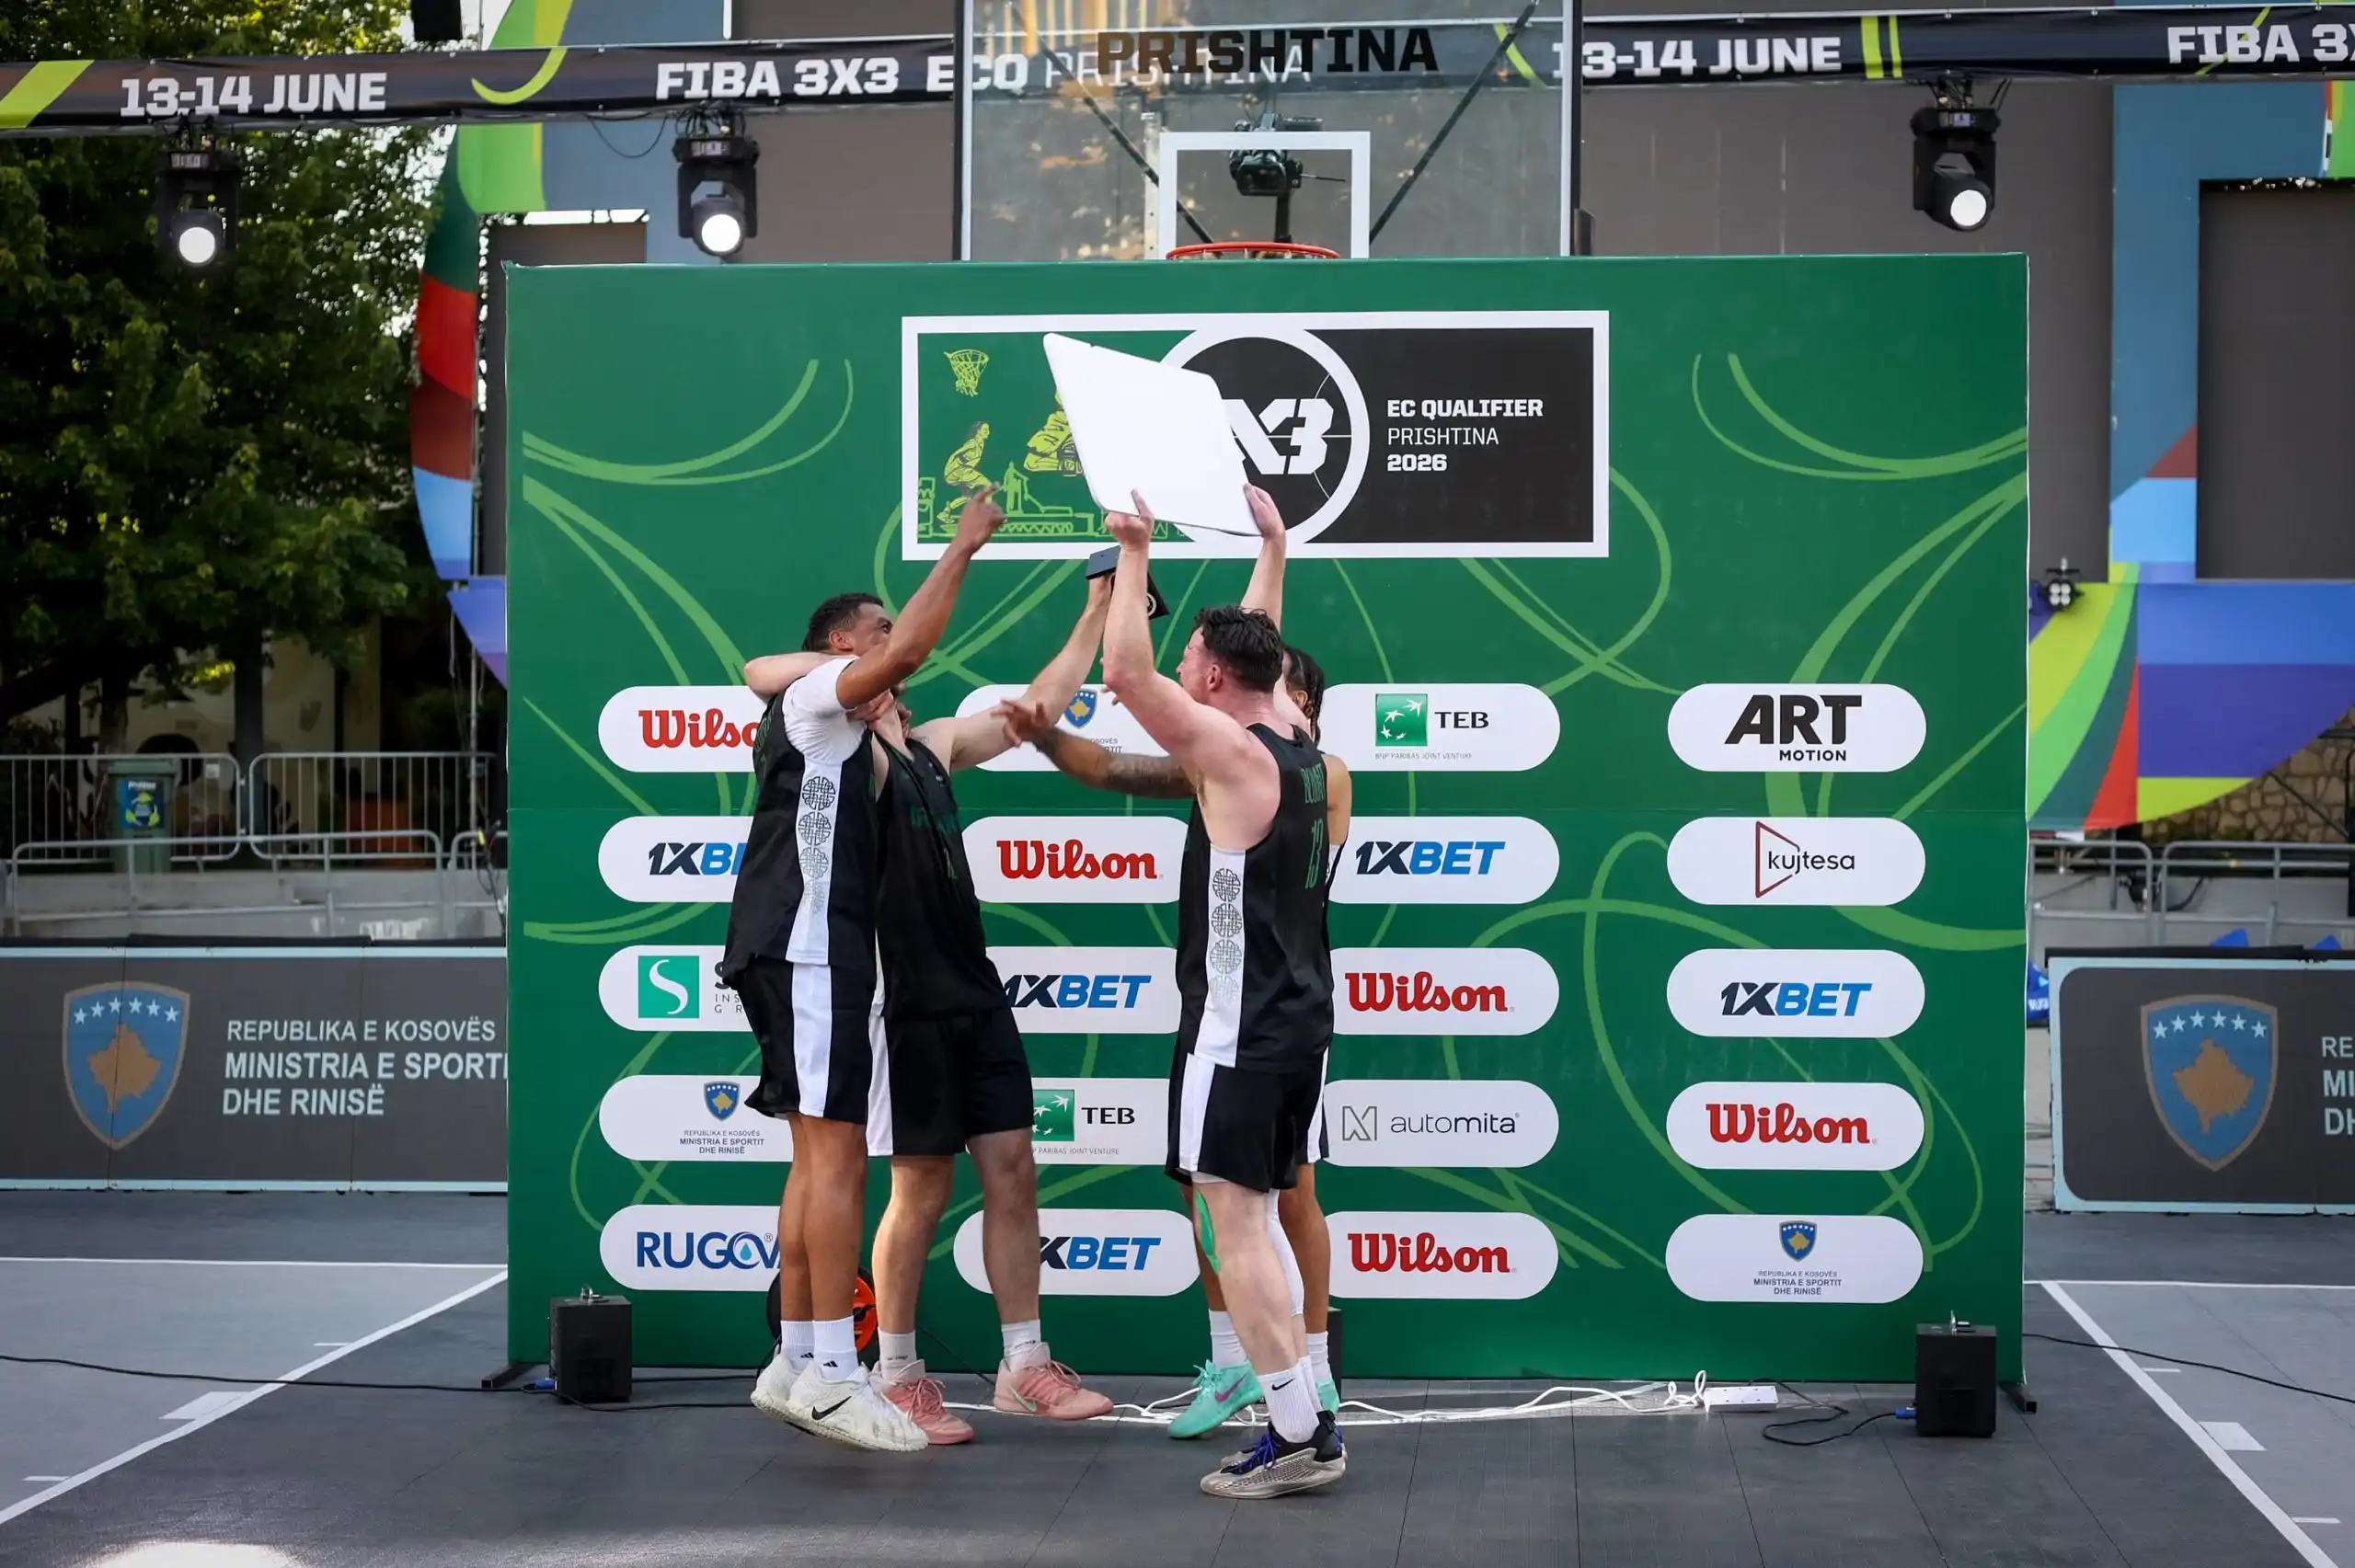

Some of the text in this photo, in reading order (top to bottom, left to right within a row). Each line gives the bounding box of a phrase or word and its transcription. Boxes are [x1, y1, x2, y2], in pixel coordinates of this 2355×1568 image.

[1097, 29, 1438, 75] PRISHTINA
[1709, 37, 1842, 74] JUNE
[2167, 24, 2355, 63] FIBA 3
[121, 72, 387, 117] 13-14 JUNE
[656, 60, 780, 100] FIBA
[793, 58, 899, 97] 3X3
[1387, 398, 1544, 420] EC QUALIFIER
[1222, 398, 1334, 475] X3
[1387, 427, 1499, 446] PRISHTINA
[1387, 454, 1447, 472] 2026
[638, 708, 762, 749] Wilso
[1434, 712, 1489, 728] TEB
[1724, 694, 1863, 745] ART
[1779, 750, 1847, 761] MOTION
[649, 842, 747, 876] 1XB
[996, 839, 1157, 879] Wilson
[1356, 841, 1506, 875] 1XBET
[1768, 851, 1855, 875] kujtesa
[1004, 975, 1152, 1008] 1XBET
[1345, 971, 1508, 1012] Wilson
[1721, 982, 1873, 1016] 1XBET
[227, 1016, 496, 1042] REPUBLIKA E KOSOVËS
[224, 1051, 508, 1080] MINISTRIA E SPORTI
[223, 1083, 385, 1116] DHE RINISË
[1081, 1107, 1135, 1124] TEB
[1390, 1113, 1516, 1134] automita
[1706, 1103, 1870, 1143] Wilson
[729, 1138, 764, 1146] SPORTIT
[637, 1231, 780, 1269] RUGOV
[1040, 1237, 1161, 1270] XBET
[1348, 1232, 1510, 1273] Wilson
[1806, 1278, 1843, 1287] SPORTIT
